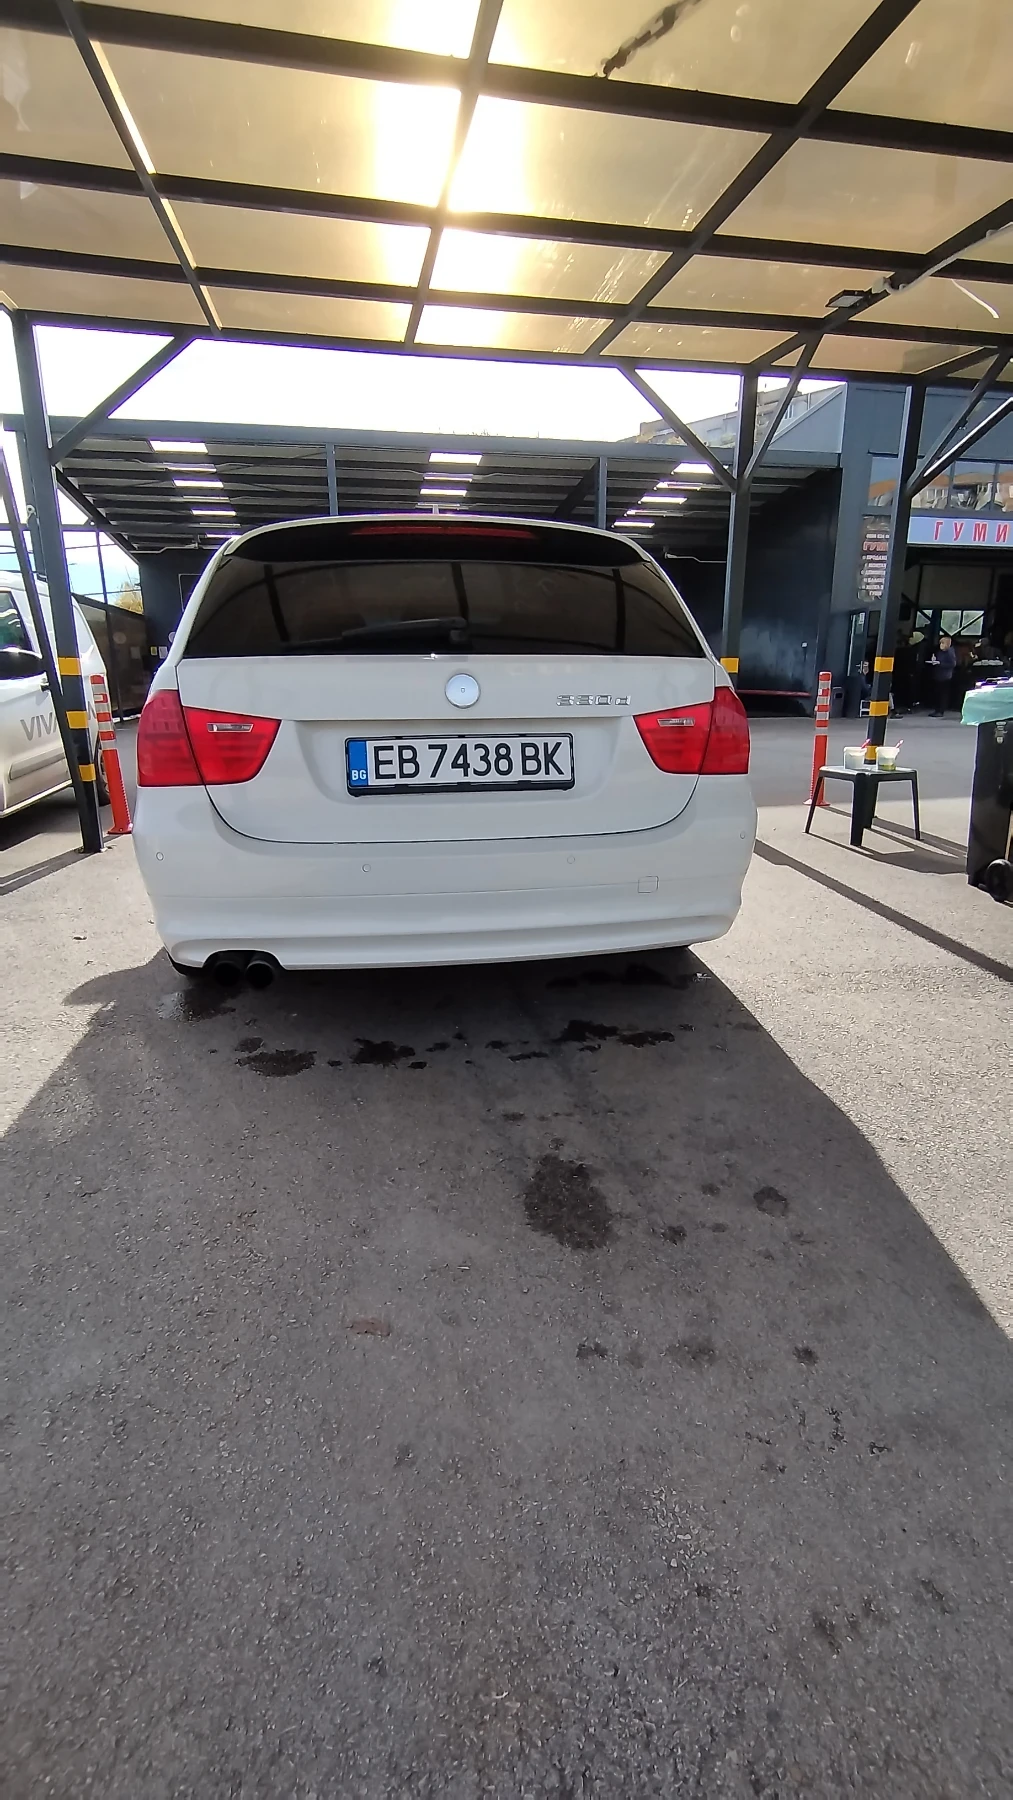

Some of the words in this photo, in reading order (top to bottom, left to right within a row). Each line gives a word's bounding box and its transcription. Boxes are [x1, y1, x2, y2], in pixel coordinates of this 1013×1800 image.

[934, 520, 1010, 544] ГУМИ
[556, 694, 631, 706] 330d
[373, 744, 420, 780] EB
[428, 742, 513, 778] 7438
[520, 741, 564, 776] BK
[351, 769, 367, 781] BG
